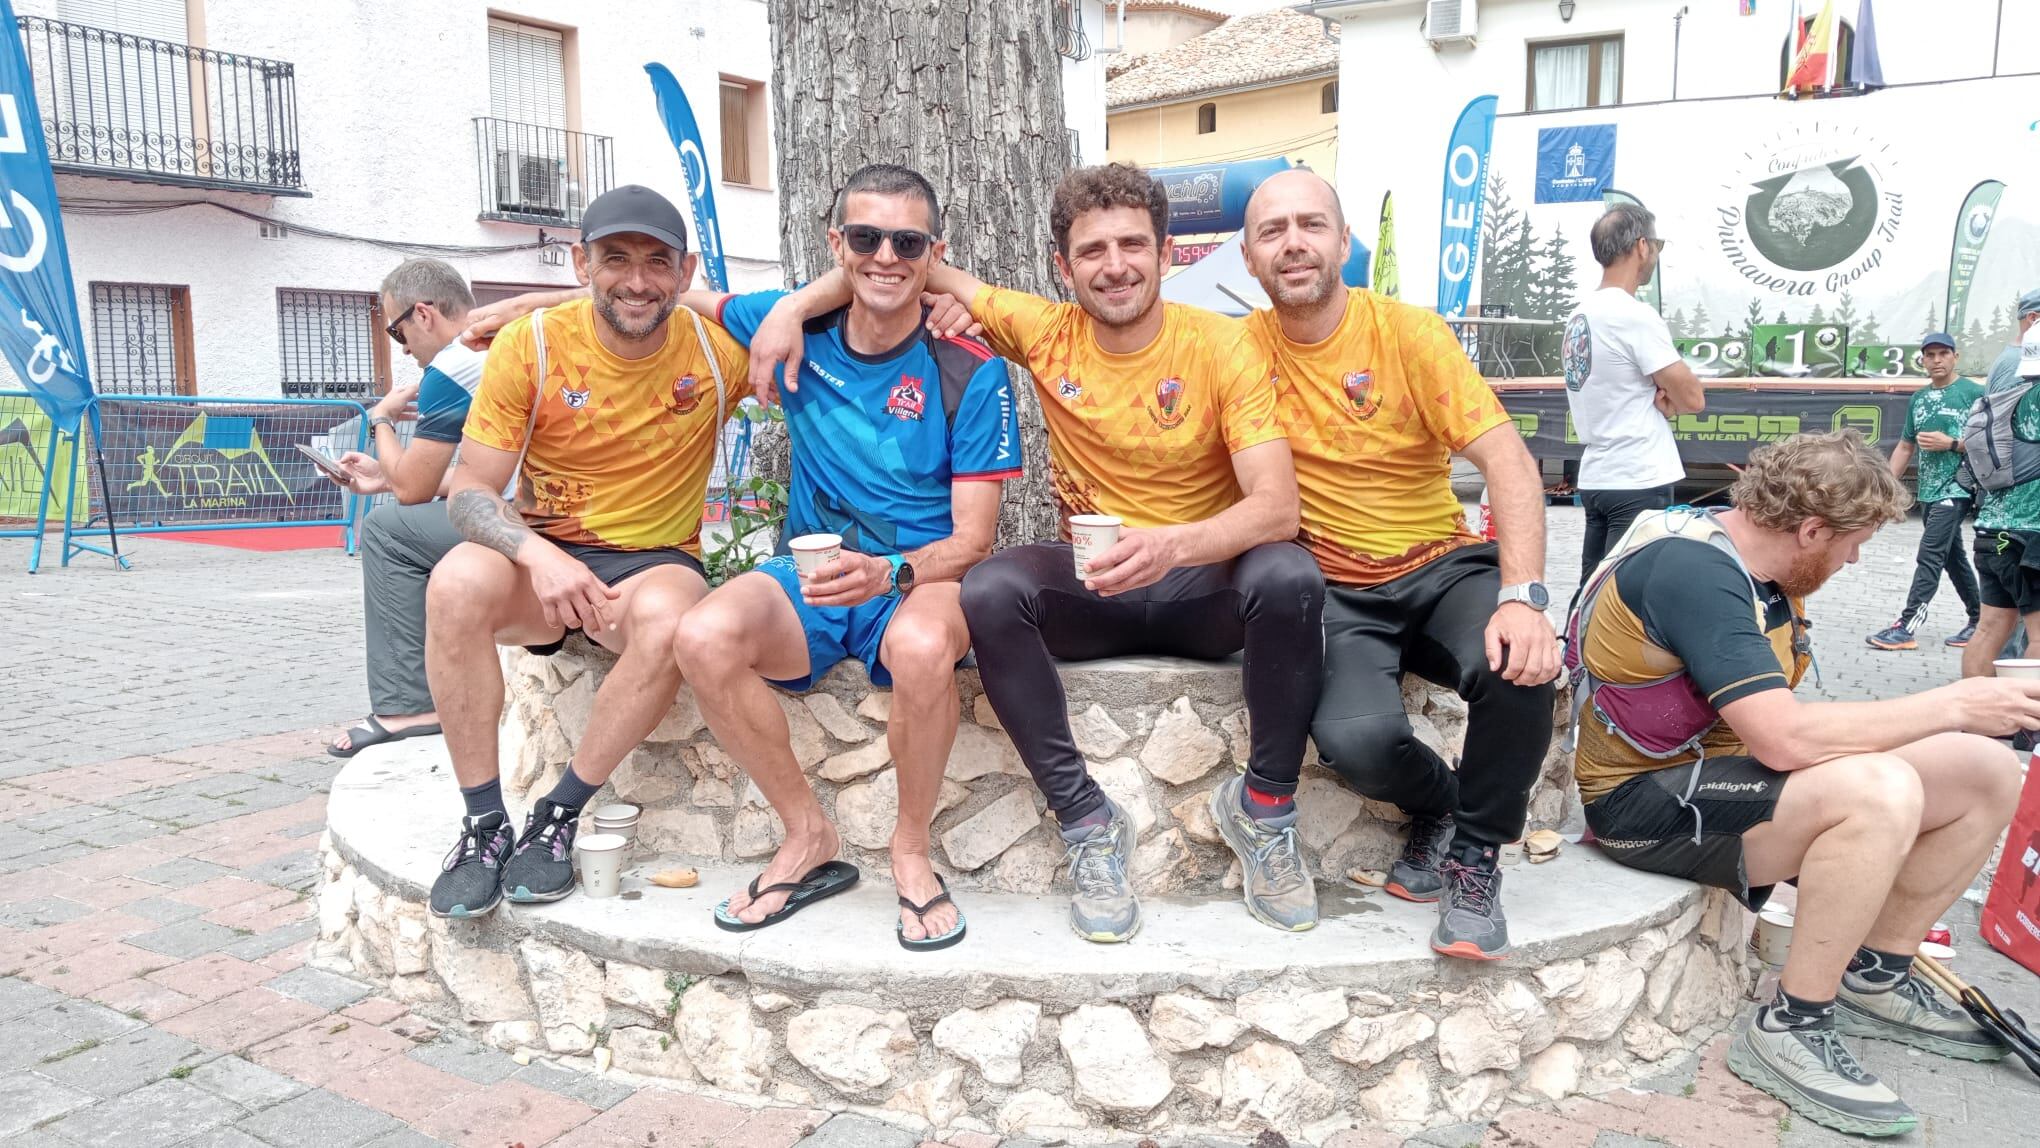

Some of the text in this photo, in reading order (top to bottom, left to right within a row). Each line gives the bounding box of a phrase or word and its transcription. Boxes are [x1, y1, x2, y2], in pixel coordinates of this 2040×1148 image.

[1441, 144, 1479, 282] GEO
[1717, 191, 1904, 296] Primavera Group Trail
[808, 359, 846, 388] FASTER
[1697, 433, 1748, 441] WEAR
[174, 454, 214, 464] CIRCUIT
[167, 463, 285, 498] TRAIL
[184, 497, 247, 509] LA MARINA
